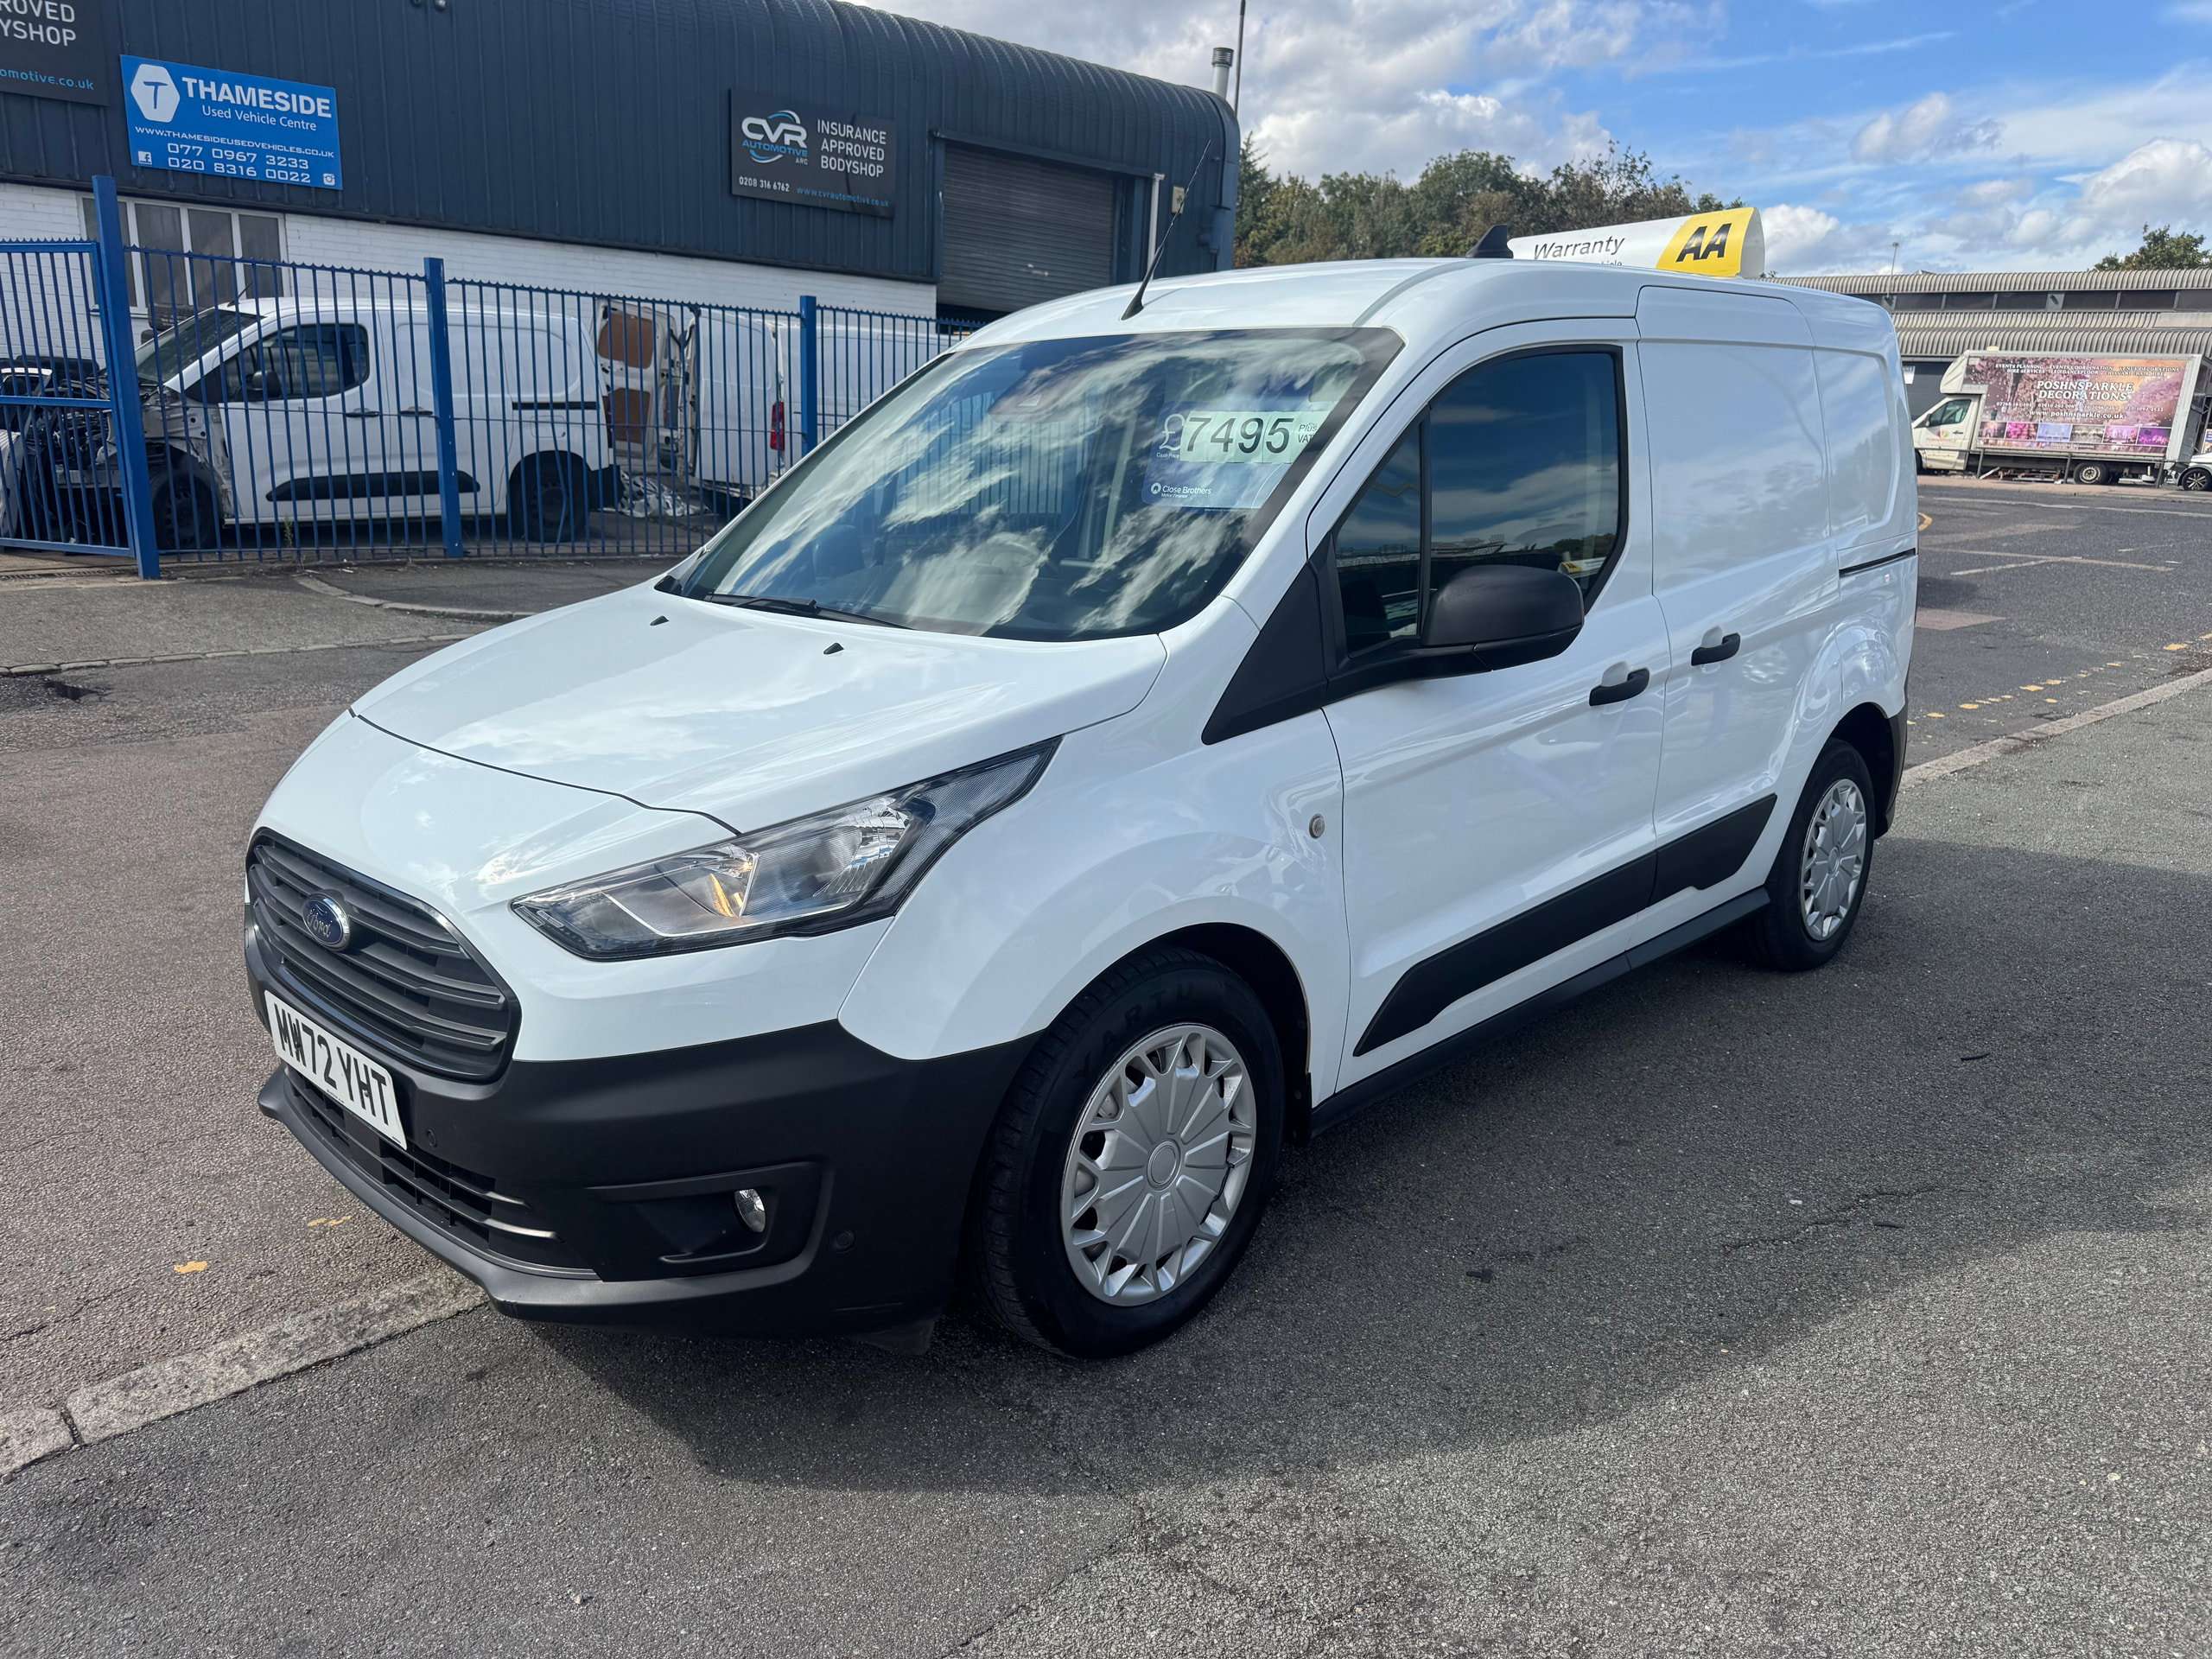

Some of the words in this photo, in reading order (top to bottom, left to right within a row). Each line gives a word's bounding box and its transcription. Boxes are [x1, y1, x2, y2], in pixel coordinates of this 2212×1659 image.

[181, 77, 333, 118] THAMESIDE
[202, 105, 232, 118] Used
[234, 110, 276, 125] Vehicle
[279, 116, 317, 131] Centre
[741, 117, 808, 149] CVR
[817, 119, 887, 145] INSURANCE
[168, 143, 203, 156] 077
[212, 148, 257, 163] 0967
[265, 155, 309, 169] 3233
[741, 139, 809, 157] AUTOMOTIVE
[821, 138, 885, 162] APPROVED
[168, 157, 205, 170] 020
[213, 162, 257, 177] 8316
[265, 168, 311, 183] 0022
[821, 156, 884, 178] BODYSHOP
[1534, 237, 1626, 260] Warranty
[1676, 223, 1732, 262] AA
[2037, 380, 2134, 391] POSHNSPARKLE
[2038, 391, 2128, 401] DECORATIONS
[1162, 485, 1181, 493] Close
[1182, 486, 1211, 495] Brothers
[336, 1046, 389, 1126] YHT
